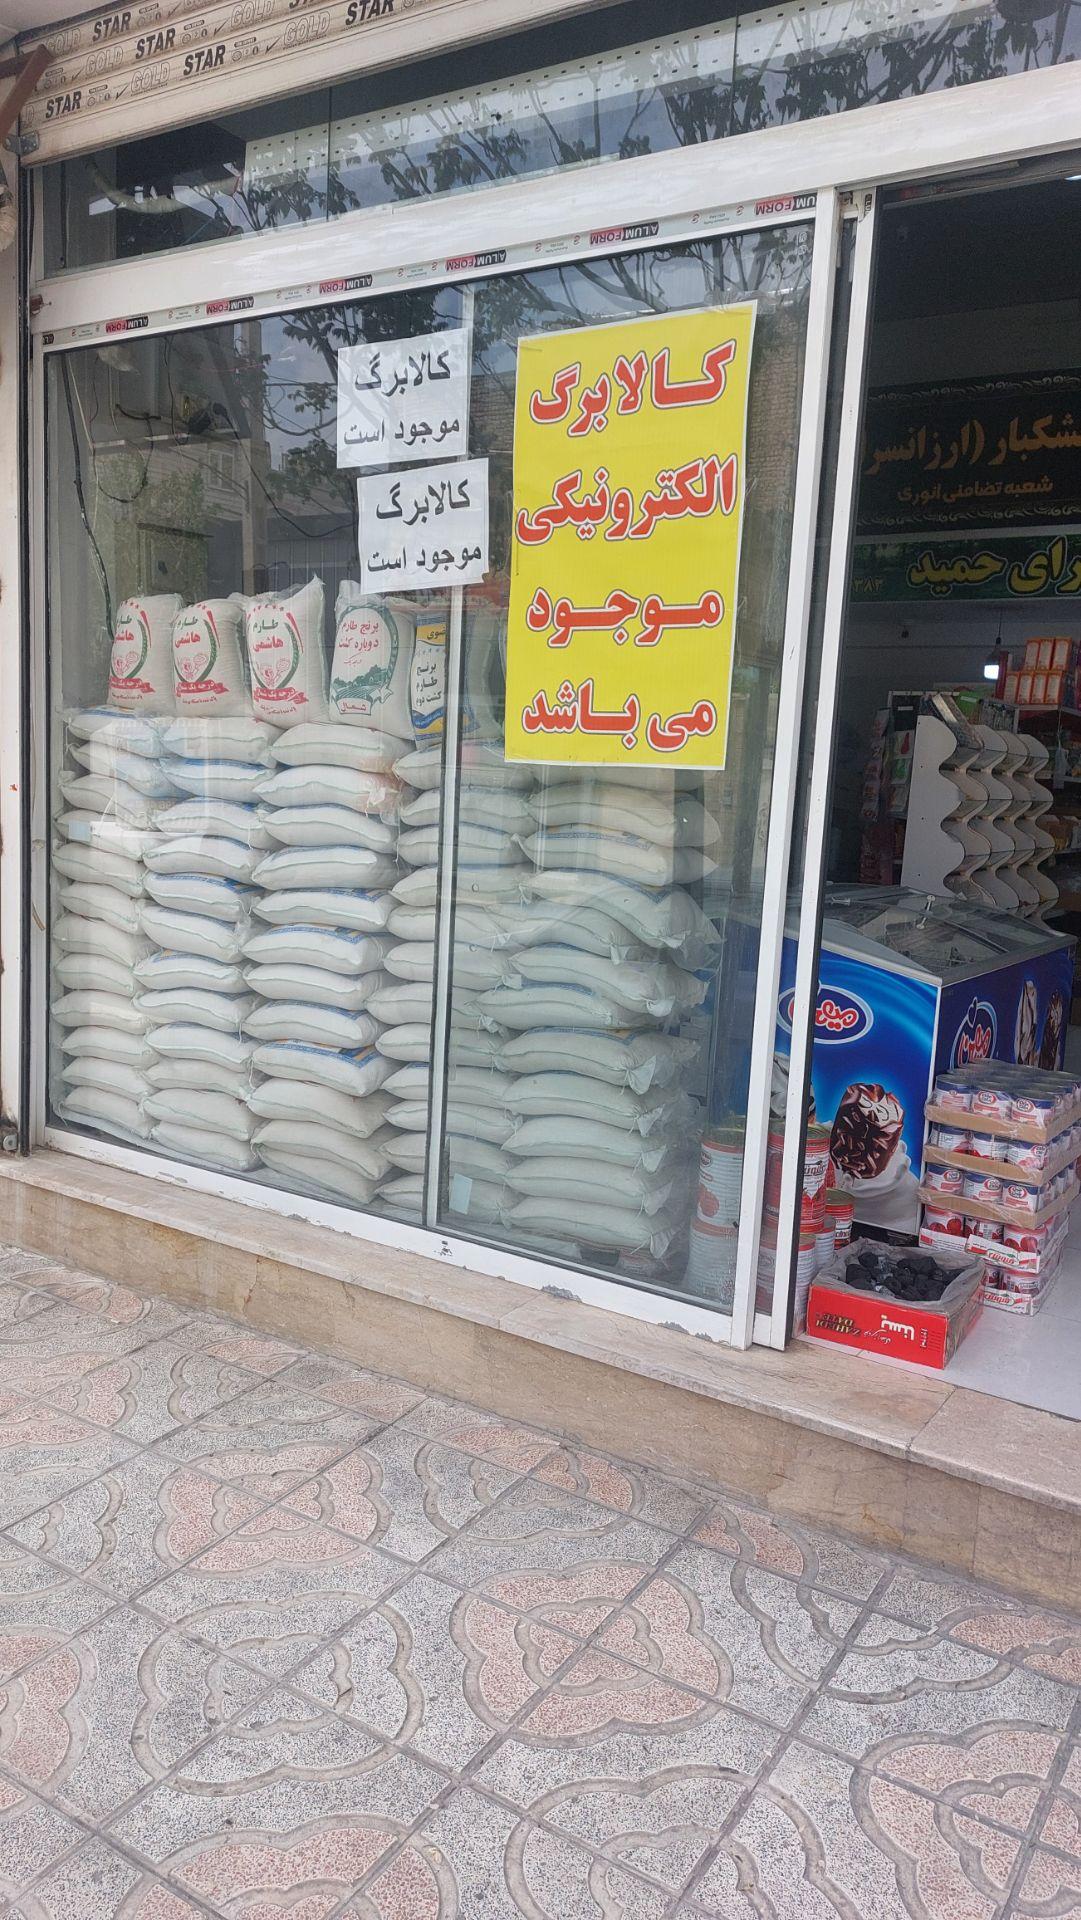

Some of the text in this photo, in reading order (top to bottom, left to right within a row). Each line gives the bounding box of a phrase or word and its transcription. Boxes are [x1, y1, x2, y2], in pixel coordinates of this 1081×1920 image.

[85, 0, 275, 76] GOLD STAR GOLD
[92, 11, 132, 42] STAR
[45, 90, 82, 119] STAR
[130, 61, 172, 93] GOLD
[183, 44, 226, 76] STAR
[283, 10, 331, 46] GOLD
[344, 0, 394, 26] STAR
[755, 192, 817, 216] UMFORM
[590, 221, 660, 247] ALUMFORM
[445, 249, 507, 271] ALUMFORM
[319, 274, 373, 294] ALUMFORM
[206, 296, 255, 316] ALUMFORM
[105, 316, 149, 334] ALUMFORM
[355, 350, 451, 397] کالابرگ
[529, 338, 737, 438] کالابرگ
[344, 418, 460, 446] موجود است
[943, 478, 1002, 503] تضامنی
[1003, 474, 1055, 498] شعبه
[376, 479, 471, 526] کالابرگ
[516, 453, 739, 545] الکترونیکی
[367, 545, 482, 573] موجود است
[906, 550, 1008, 598] حمید
[253, 619, 279, 633] طارم
[360, 620, 379, 635] برنج
[525, 587, 725, 649] موجود
[175, 631, 201, 649] هاشمی
[253, 635, 284, 652] هاشمی
[522, 676, 718, 754] می باشد
[814, 1319, 862, 1338] ZAHEDI
[821, 1312, 855, 1328] DATE
